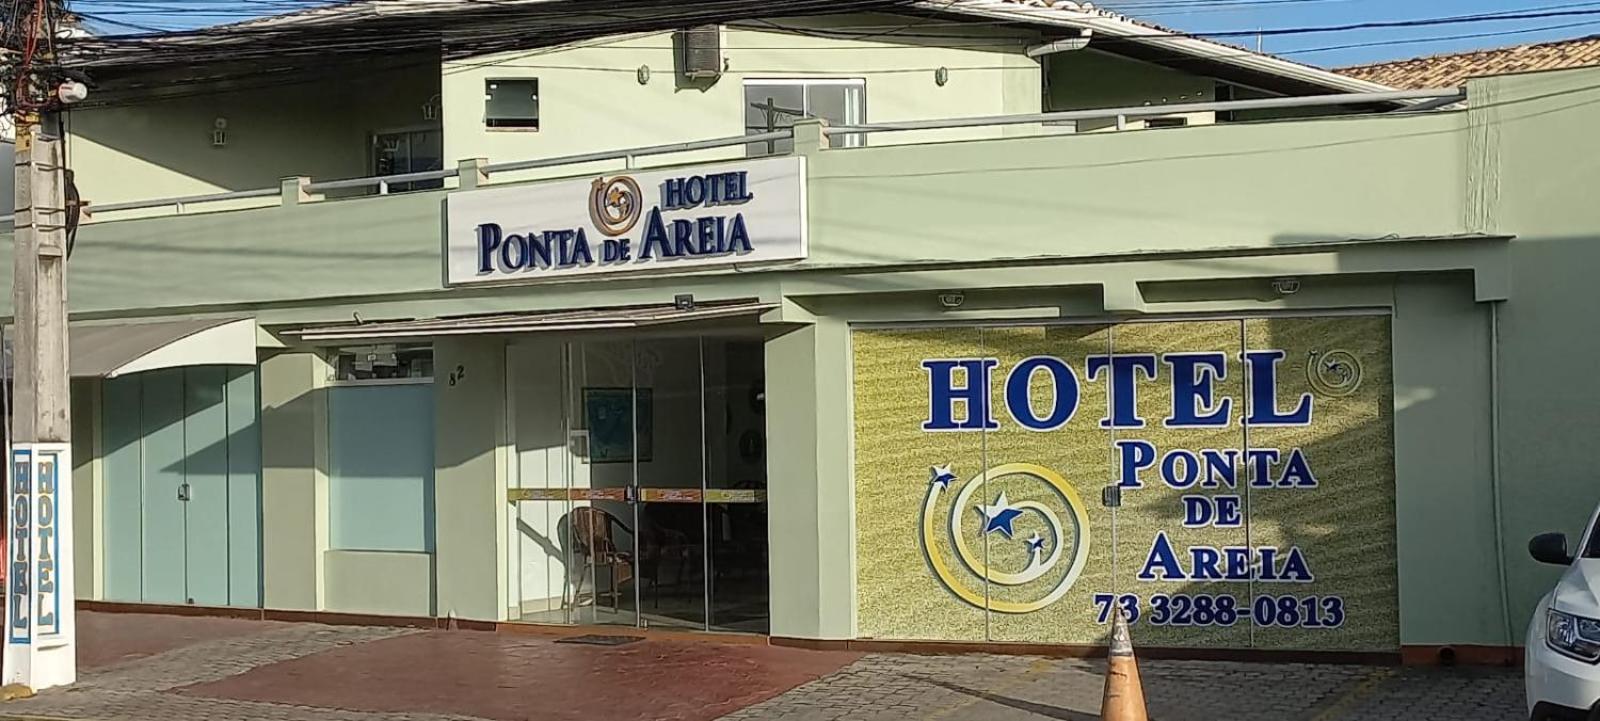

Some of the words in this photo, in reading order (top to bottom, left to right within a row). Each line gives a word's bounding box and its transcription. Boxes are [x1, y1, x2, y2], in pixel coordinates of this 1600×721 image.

[661, 171, 753, 209] HOTEL
[476, 223, 594, 274] PONTA
[602, 239, 630, 263] DE
[636, 206, 754, 260] AREIA
[922, 350, 1313, 432] HOTEL
[1115, 440, 1318, 490] PONTA
[1182, 495, 1242, 528] DE
[13, 461, 29, 629] HOTEL
[38, 461, 54, 627] HOTEL
[1138, 531, 1313, 583] AREIA
[1094, 593, 1140, 625] 73
[1149, 594, 1345, 629] 3288-0813
